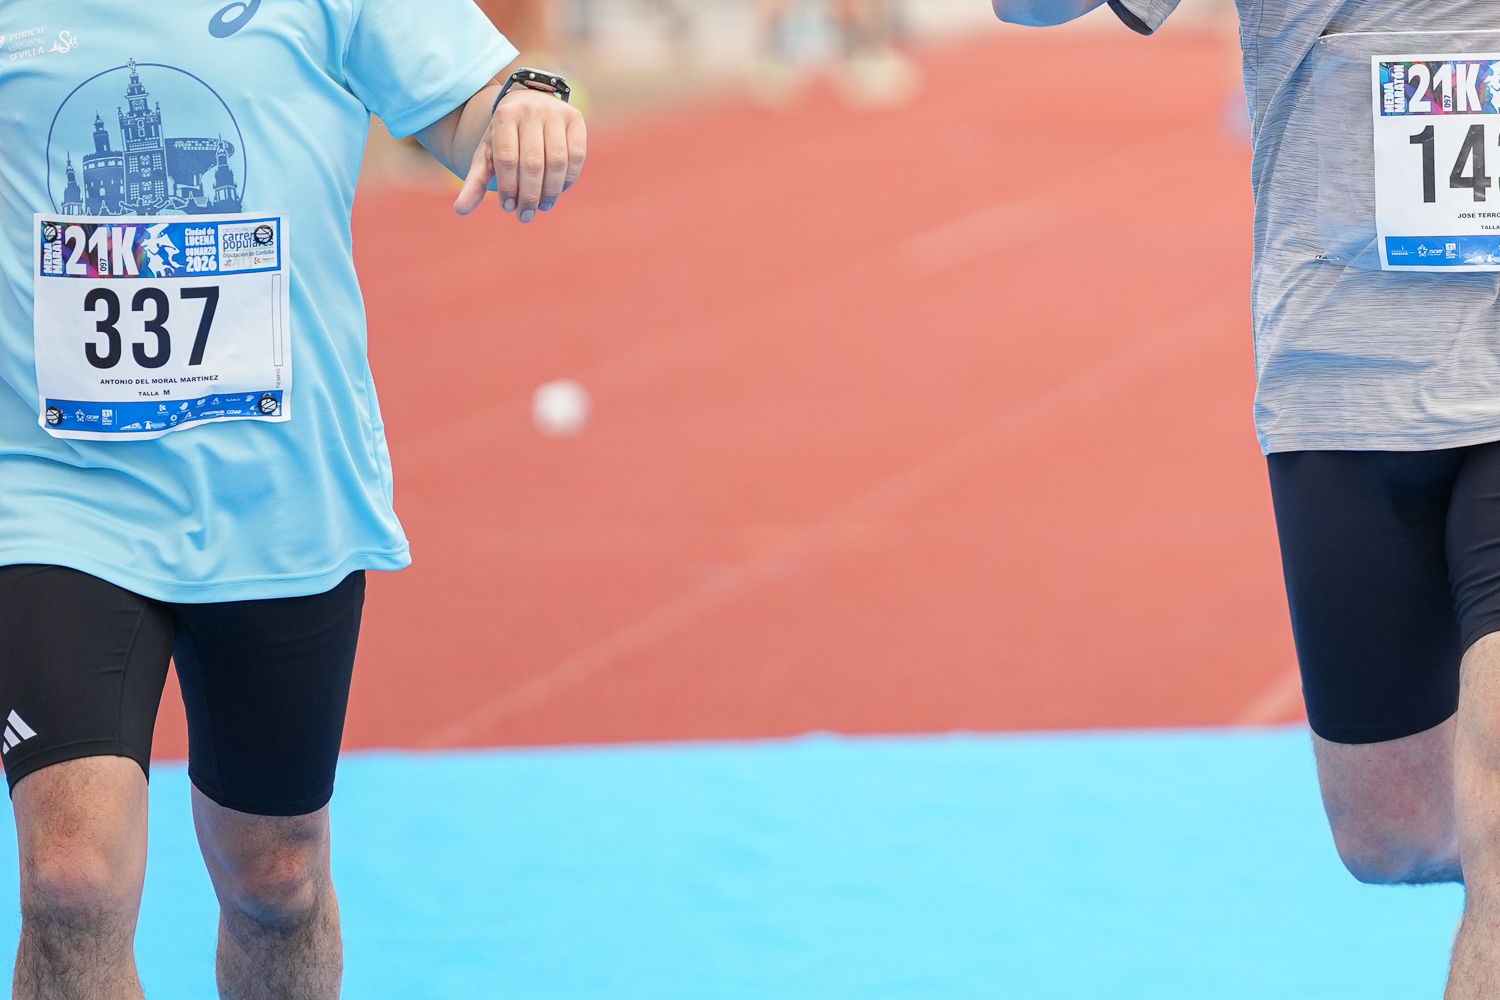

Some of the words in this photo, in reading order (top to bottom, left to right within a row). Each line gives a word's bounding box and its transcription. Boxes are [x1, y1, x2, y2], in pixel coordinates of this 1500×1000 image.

[8, 46, 45, 62] SEVILLA
[1384, 82, 1394, 112] MEDIA
[1409, 63, 1482, 112] 21K
[65, 226, 139, 275] 21K
[185, 234, 215, 246] LUCENA
[44, 242, 53, 274] MEDIA
[186, 255, 217, 272] 2026
[84, 285, 220, 369] 337
